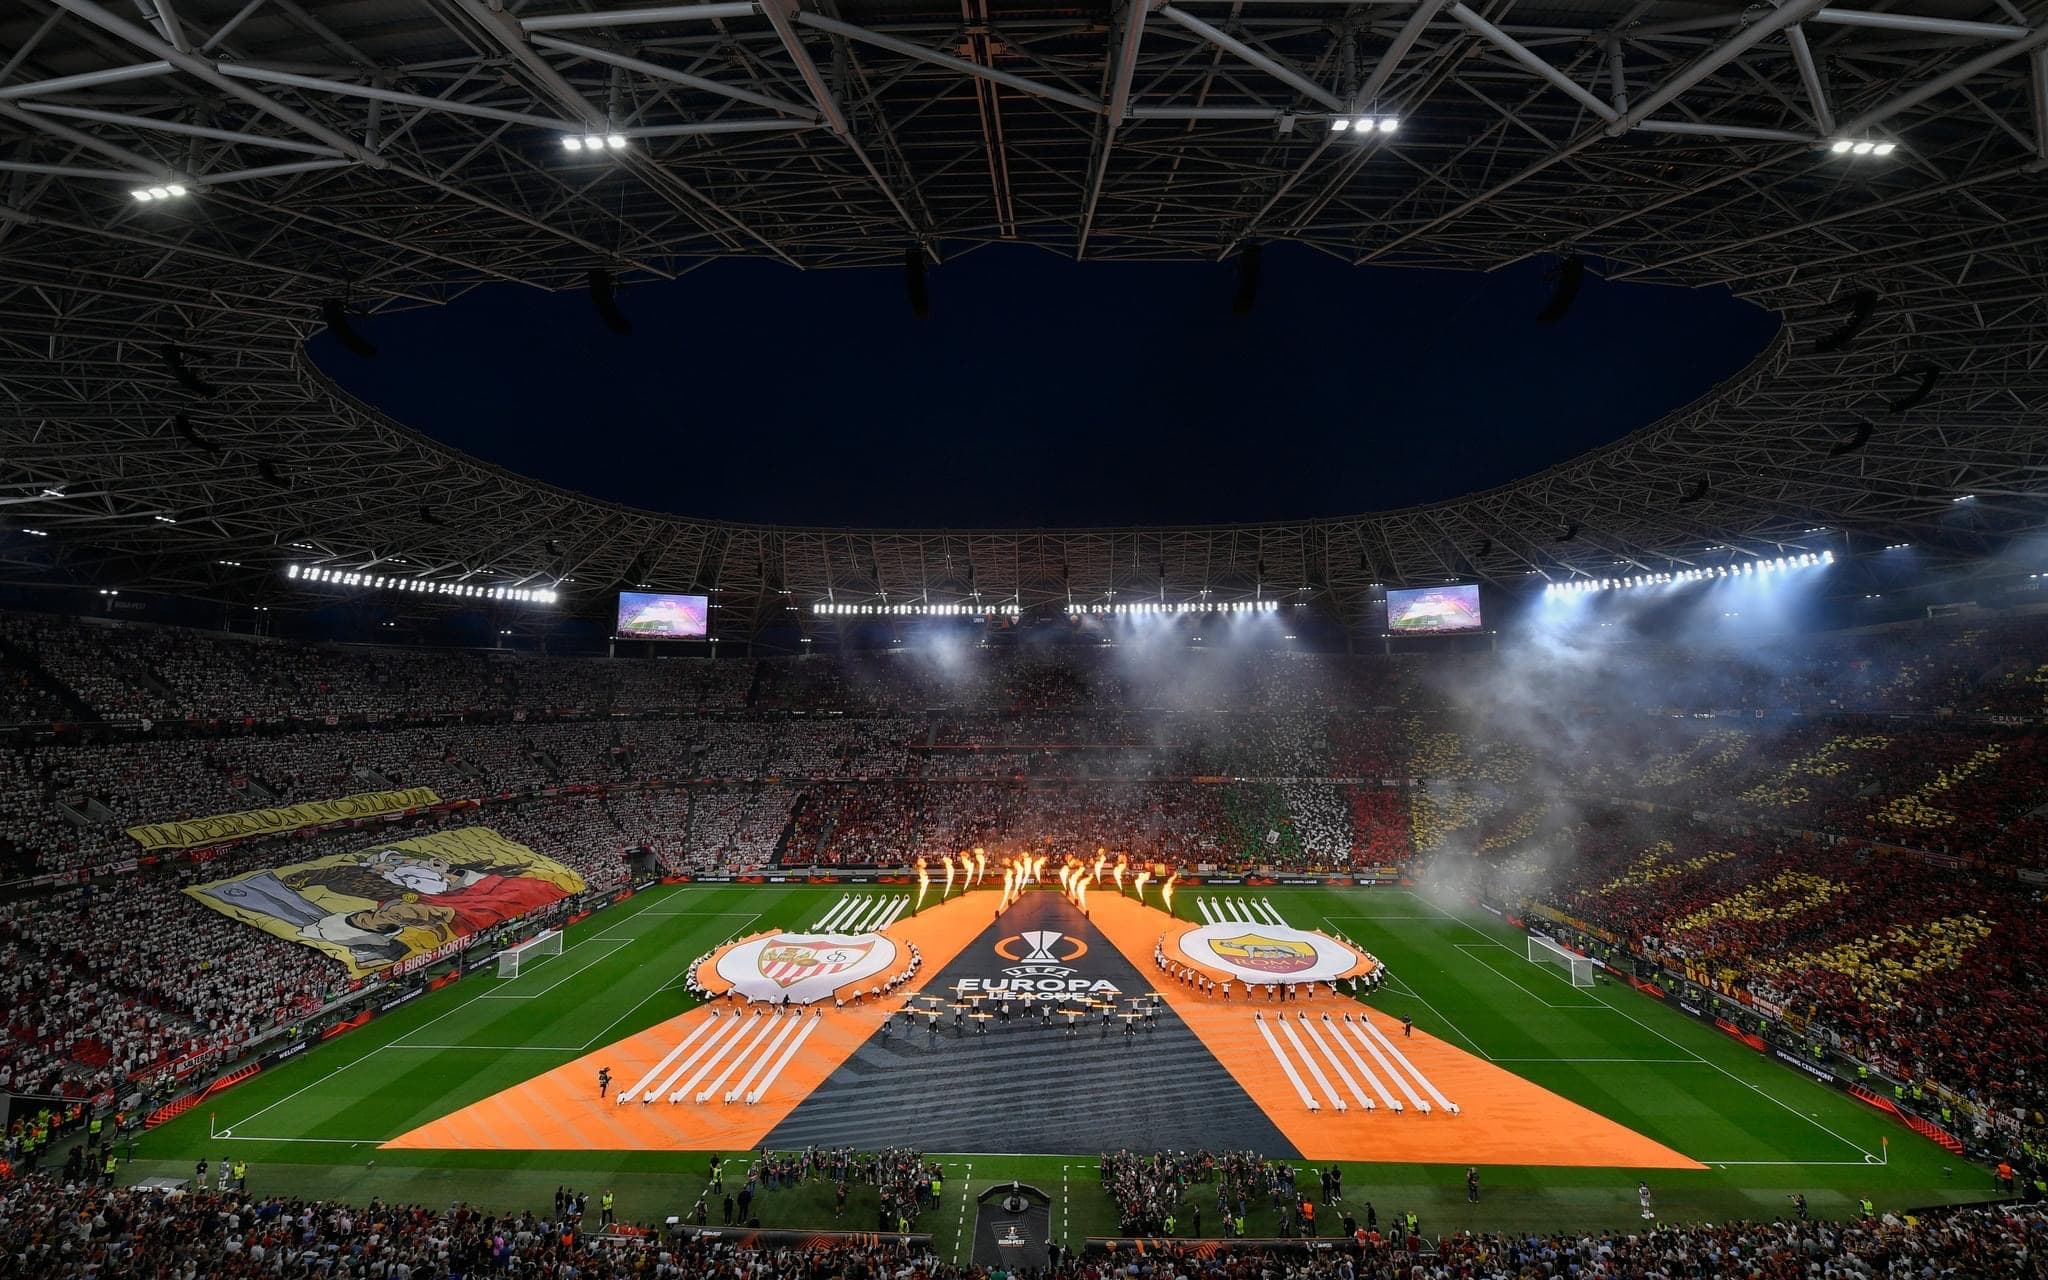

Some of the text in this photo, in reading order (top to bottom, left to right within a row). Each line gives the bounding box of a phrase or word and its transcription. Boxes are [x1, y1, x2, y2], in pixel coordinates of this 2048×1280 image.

[142, 789, 432, 846] IMPERIUM NOSTRUM
[404, 934, 471, 972] BIRIS NORTE
[1234, 957, 1309, 966] ROMA
[1004, 966, 1071, 977] UEFA
[957, 978, 1121, 992] EUROPA
[1680, 1001, 1702, 1016] WELCOME
[278, 1041, 306, 1060] WELCOME
[1776, 1050, 1834, 1082] OPENING CEREMONY
